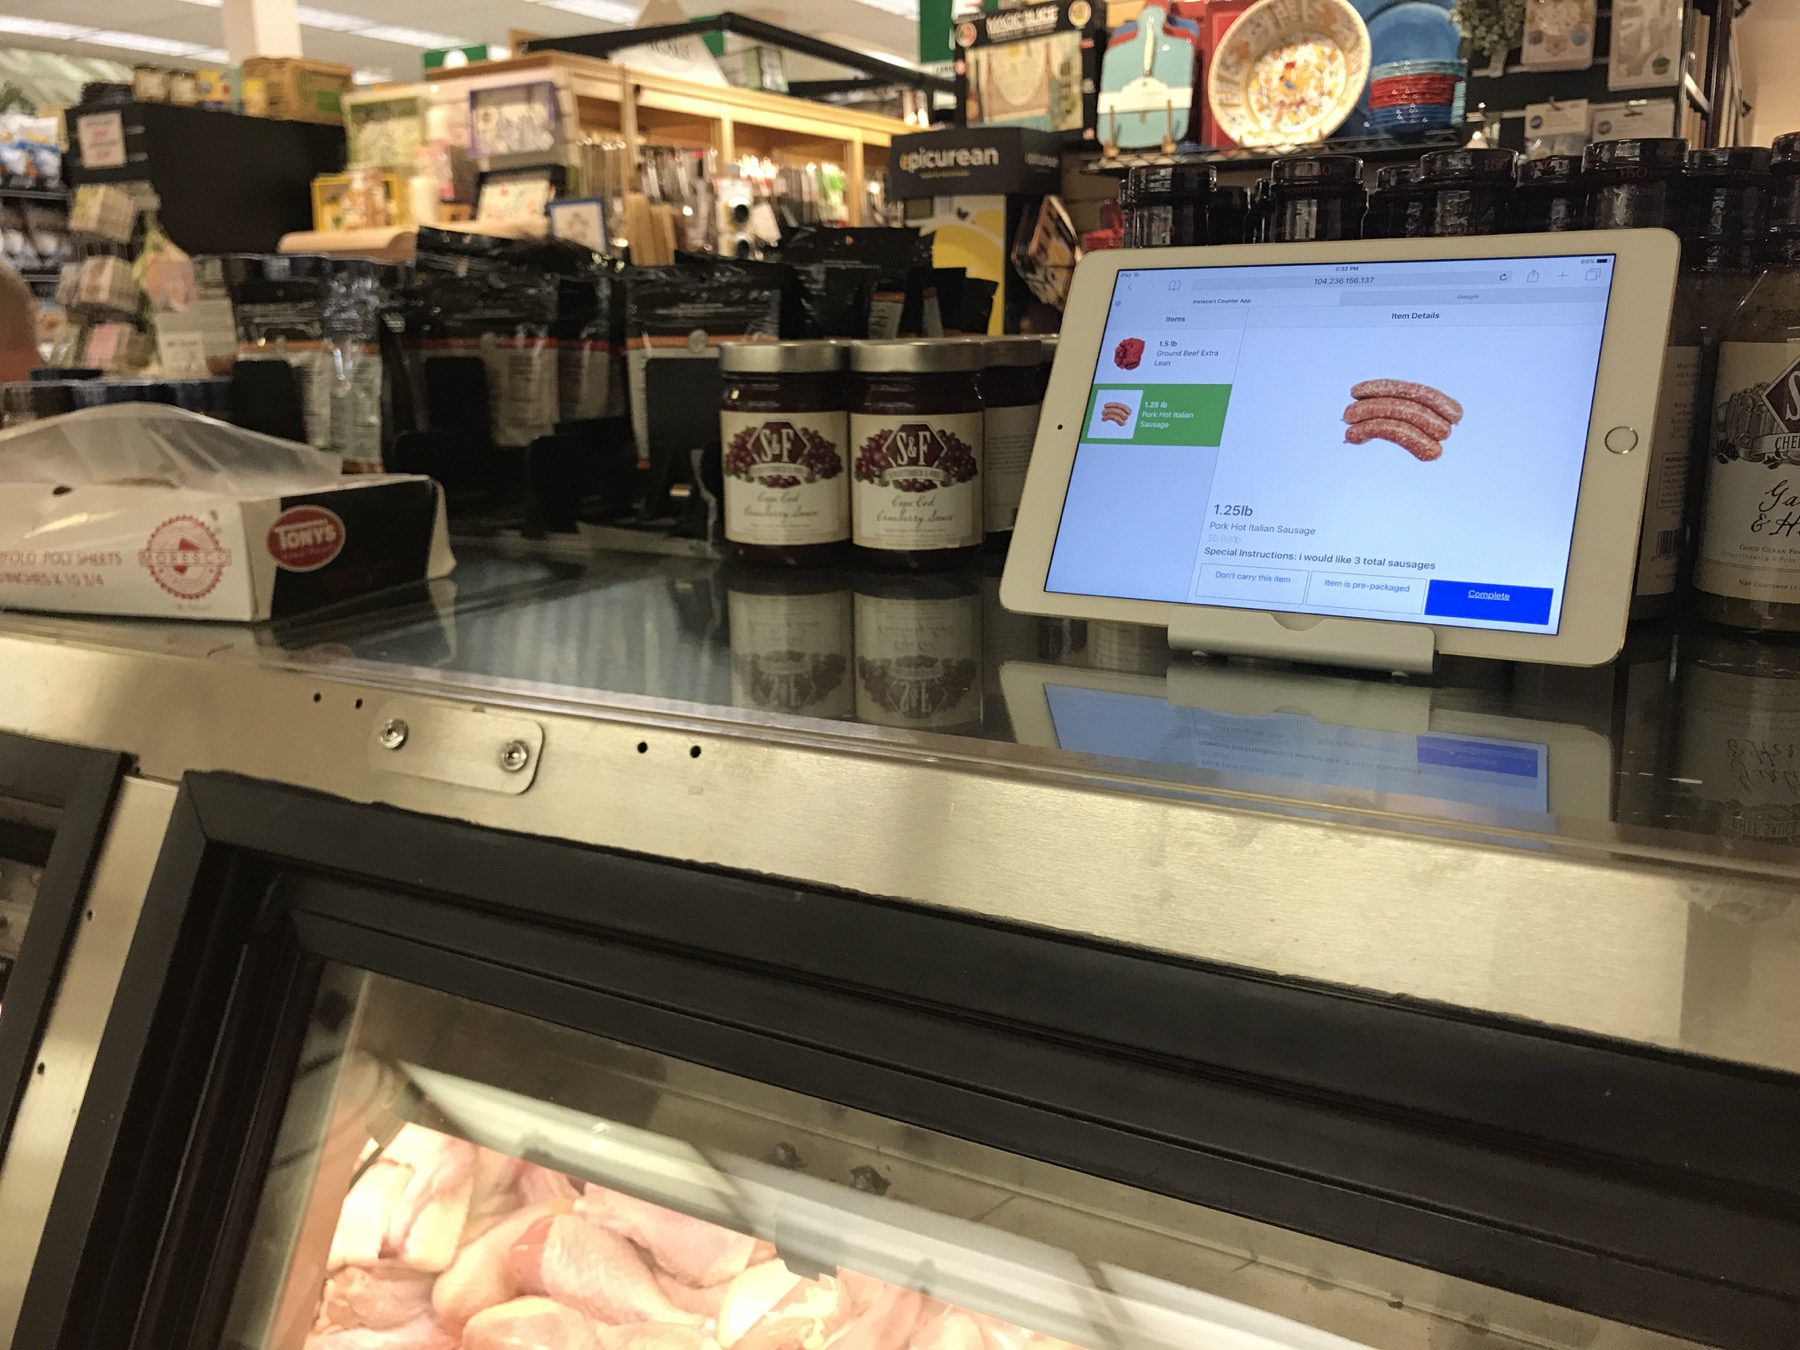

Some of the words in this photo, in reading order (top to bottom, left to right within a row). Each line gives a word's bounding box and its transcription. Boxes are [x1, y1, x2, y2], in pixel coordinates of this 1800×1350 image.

[899, 146, 999, 174] epicurean
[1314, 276, 1374, 285] 104.236.156.137
[1391, 312, 1410, 320] Item
[1411, 312, 1440, 320] Details
[1140, 421, 1169, 429] Sausage
[760, 429, 795, 462] S&F
[896, 431, 931, 465] S&F
[1214, 504, 1254, 517] 1.25lb
[1210, 522, 1229, 530] Pork
[1230, 522, 1246, 531] Hot
[1248, 524, 1275, 533] Italian
[1277, 526, 1316, 536] Sausage
[1750, 513, 1771, 532] &
[1204, 547, 1238, 557] Special
[1239, 548, 1297, 561] Instructions:
[1298, 552, 1302, 560] i
[1304, 554, 1333, 563] would
[1335, 555, 1352, 564] like
[1354, 556, 1361, 565] 3
[1363, 557, 1386, 567] total
[1388, 560, 1436, 571] sausages
[1215, 571, 1236, 579] Don't
[1236, 573, 1257, 582] carry
[1258, 574, 1272, 582] this
[1274, 575, 1291, 583] item
[1324, 580, 1342, 588] Item
[1352, 582, 1411, 593] pre-packaged
[1468, 590, 1510, 601] Complete
